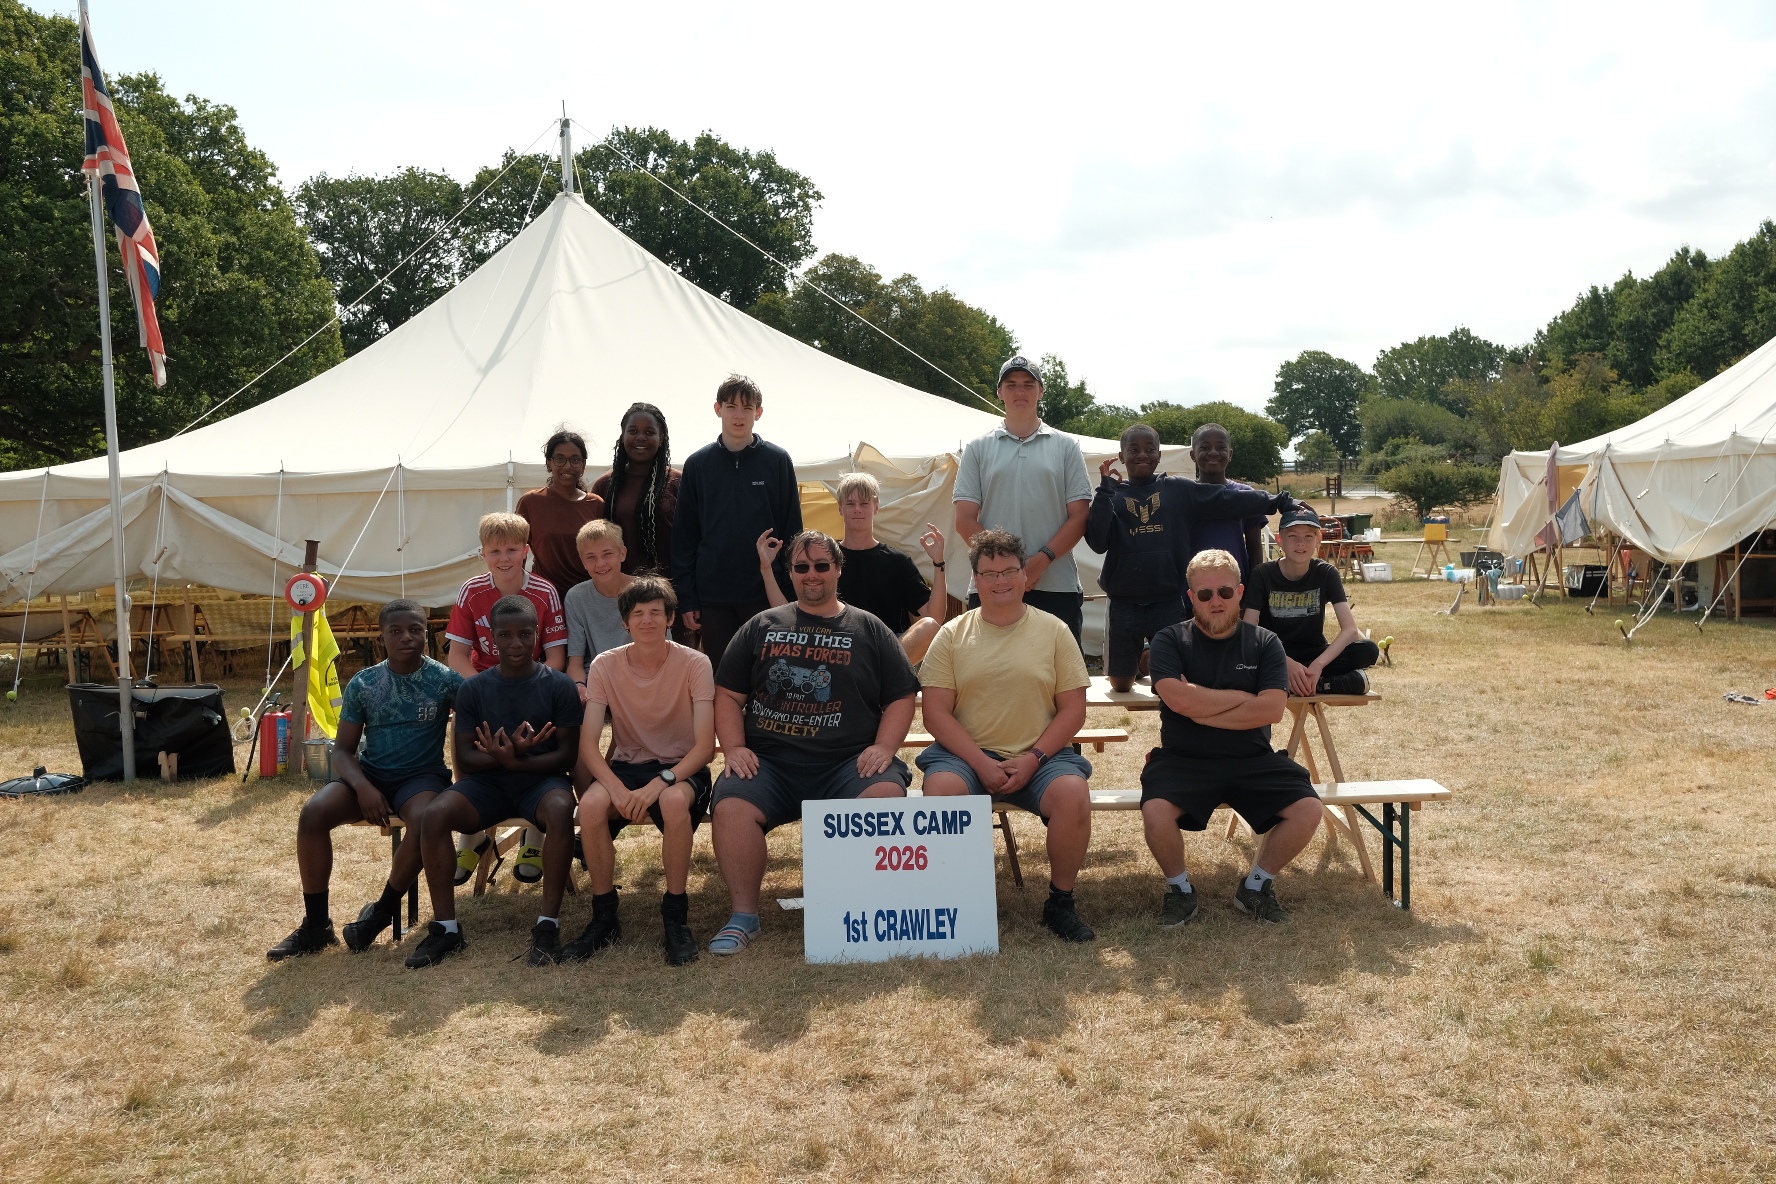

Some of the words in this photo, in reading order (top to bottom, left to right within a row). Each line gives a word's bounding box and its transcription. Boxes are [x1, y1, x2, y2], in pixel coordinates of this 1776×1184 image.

[765, 632, 808, 644] READ
[814, 634, 852, 648] THIS
[815, 627, 832, 635] CAN
[769, 644, 802, 657] WAS
[805, 647, 852, 665] FORCED
[752, 699, 773, 718] DOWN
[771, 711, 790, 722] AND
[791, 712, 842, 727] RE-ENTER
[756, 717, 820, 737] SOCIETY
[823, 811, 905, 838] SUSSEX
[913, 810, 972, 835] CAMP
[875, 845, 928, 871] 2026
[843, 911, 868, 943] 1st
[874, 907, 958, 942] CRAWLEY
